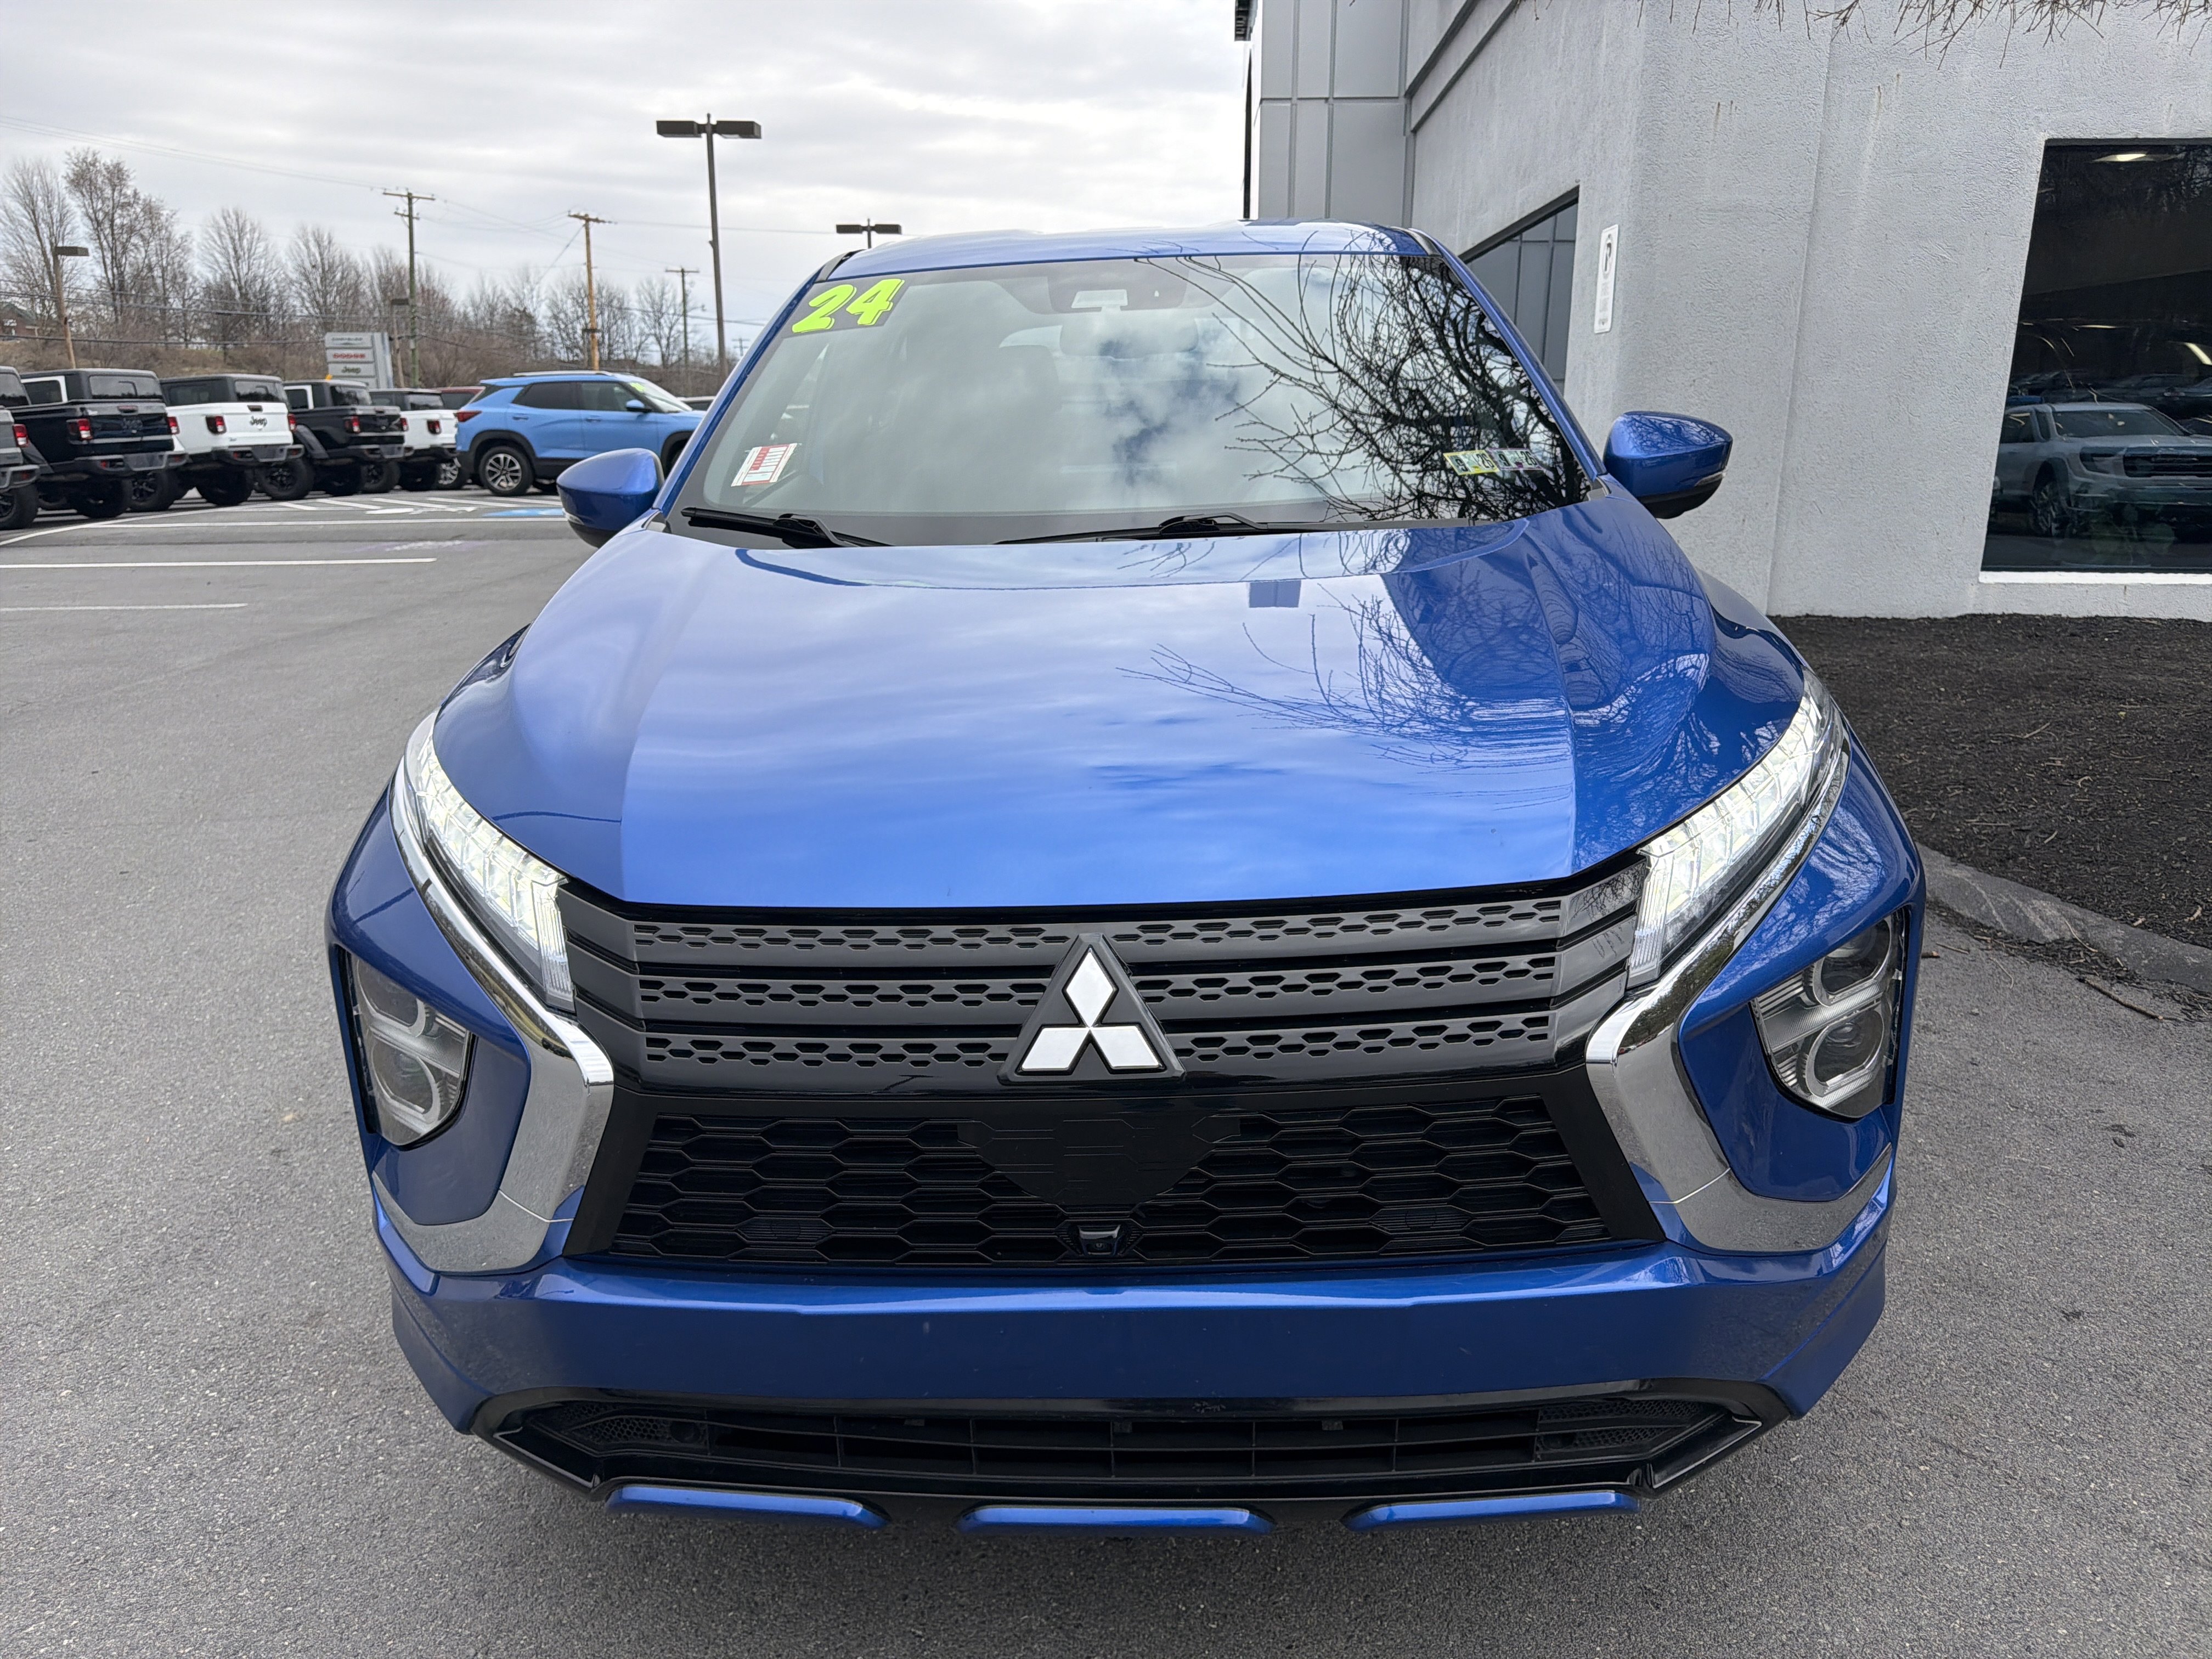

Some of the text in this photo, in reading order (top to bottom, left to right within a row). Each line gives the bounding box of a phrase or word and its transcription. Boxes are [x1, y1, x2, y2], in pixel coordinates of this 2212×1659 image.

[792, 279, 905, 334] 24
[250, 415, 268, 427] Jeep
[1498, 454, 1511, 466] 9
